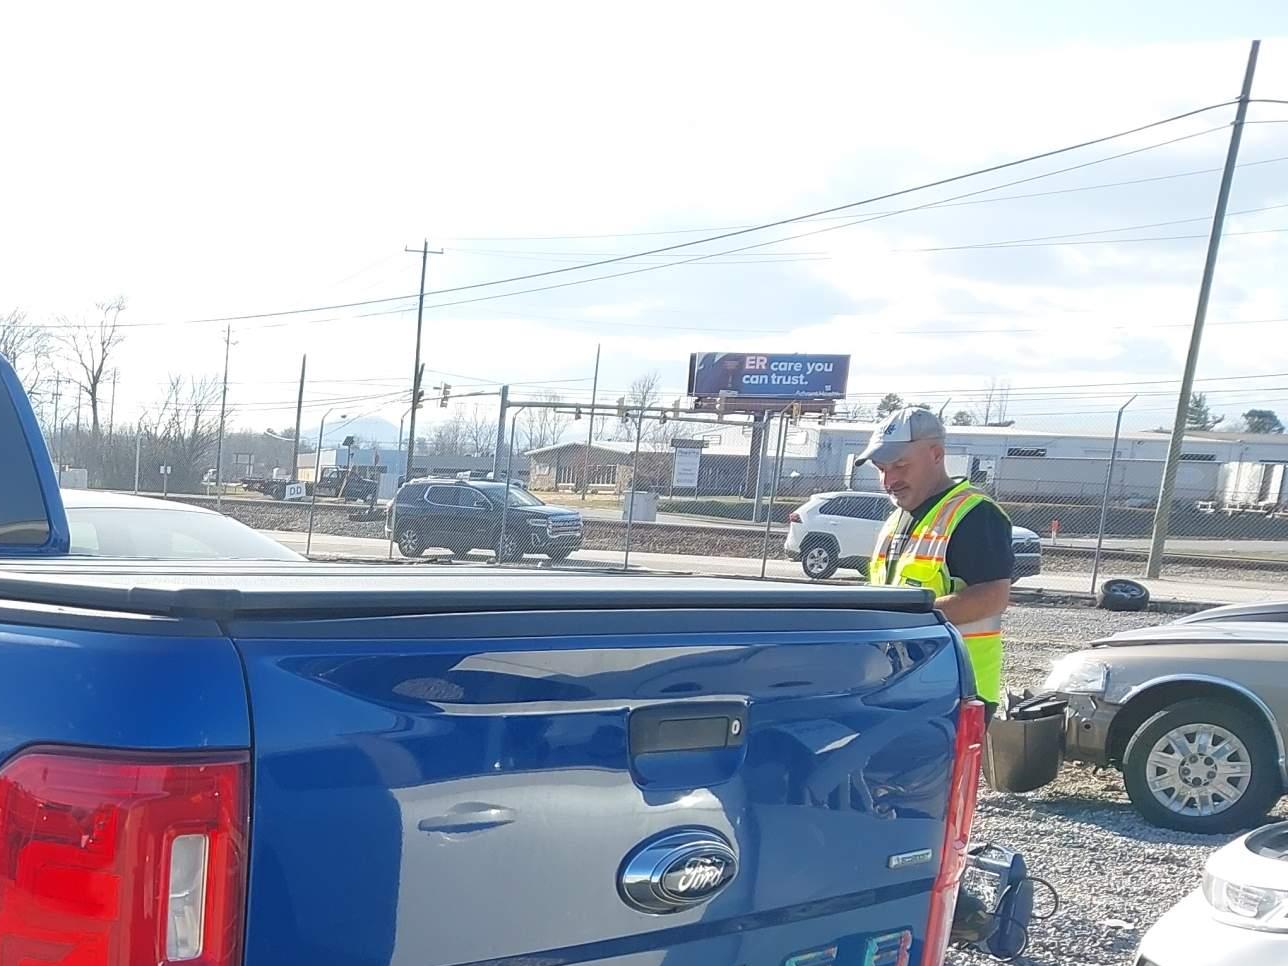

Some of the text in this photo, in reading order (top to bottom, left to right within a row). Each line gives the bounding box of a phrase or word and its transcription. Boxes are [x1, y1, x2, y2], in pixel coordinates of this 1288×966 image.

[745, 356, 833, 374] ER care you
[742, 373, 808, 385] can trust.
[677, 857, 725, 892] Ford
